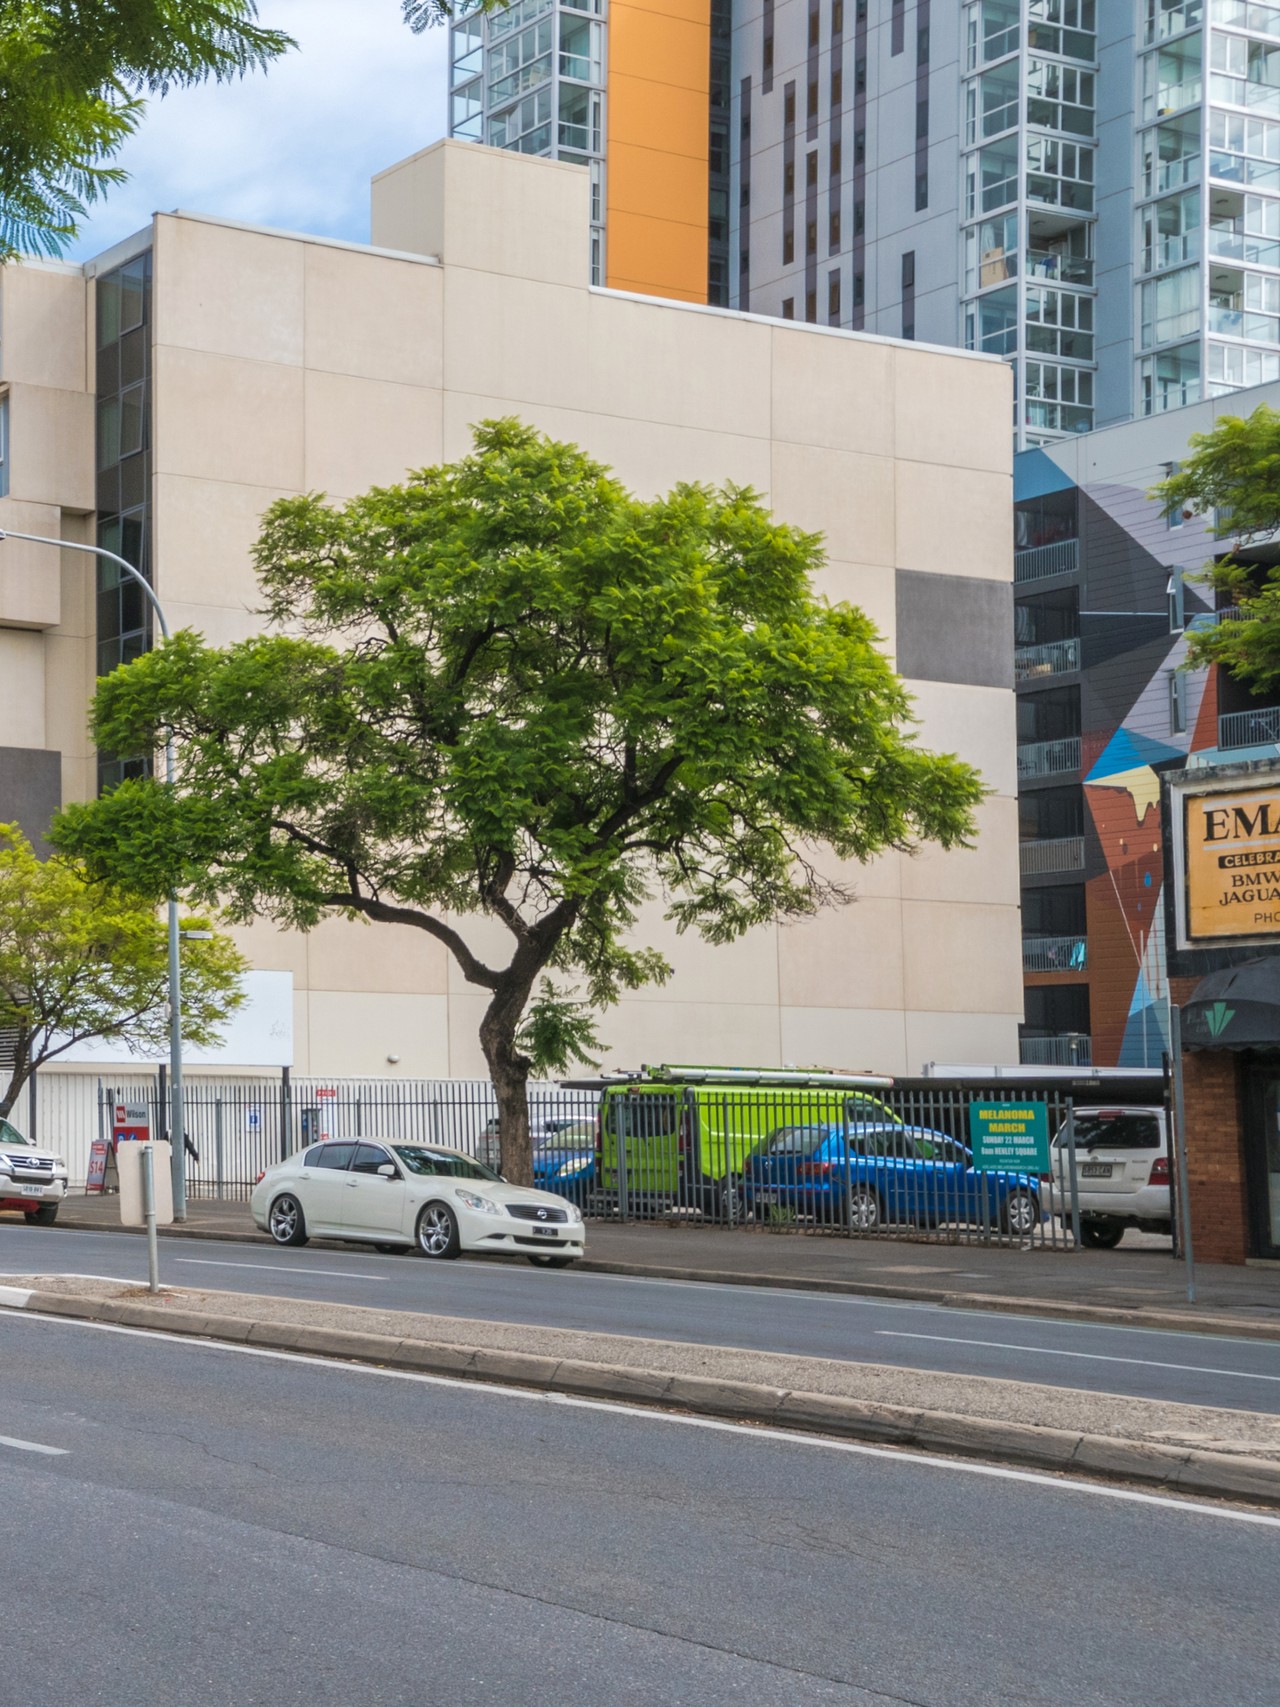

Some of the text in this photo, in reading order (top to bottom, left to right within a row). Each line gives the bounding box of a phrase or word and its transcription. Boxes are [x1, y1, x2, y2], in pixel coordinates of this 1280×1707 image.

[1203, 804, 1280, 841] EM
[1231, 871, 1280, 887] BMW
[1219, 888, 1280, 906] JAGUA
[127, 1110, 146, 1118] Wilson
[979, 1110, 1035, 1120] MELANOMA
[989, 1123, 1026, 1133] MARCH
[1015, 1147, 1037, 1156] SQUARE
